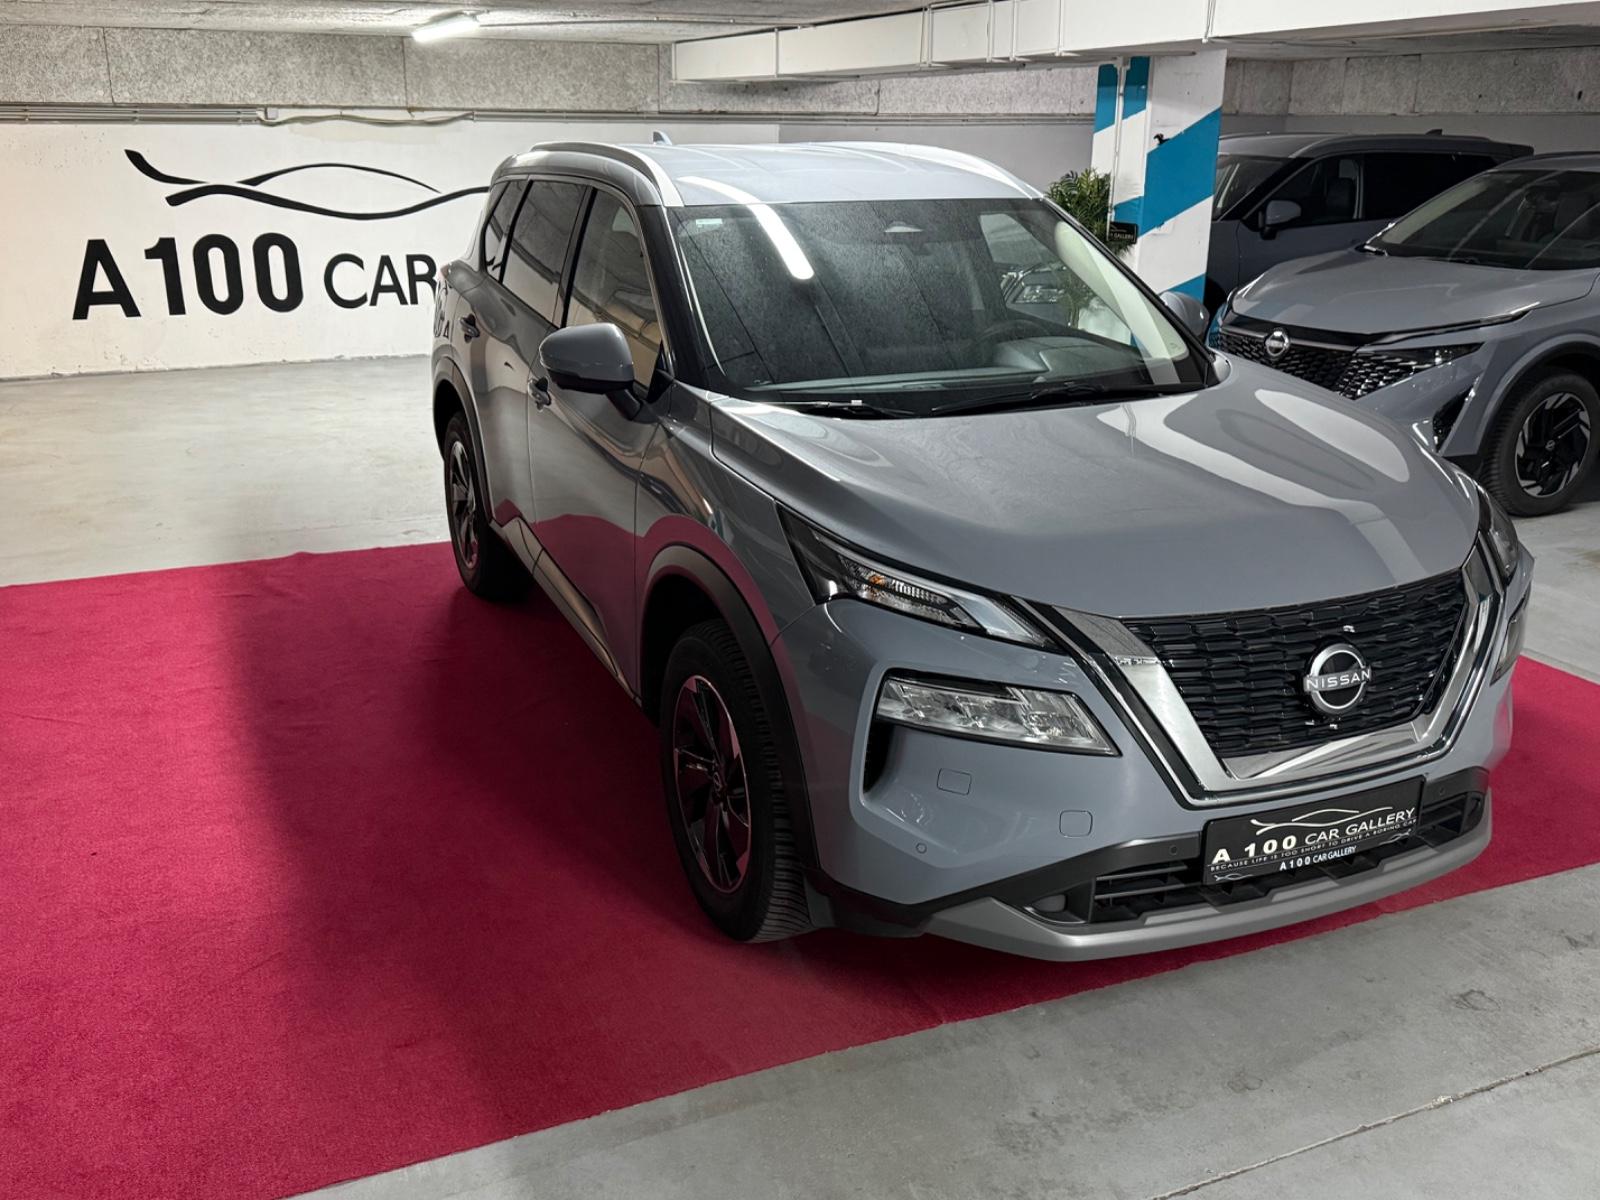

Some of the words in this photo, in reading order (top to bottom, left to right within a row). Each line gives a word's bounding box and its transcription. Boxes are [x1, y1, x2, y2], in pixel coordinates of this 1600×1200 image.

[323, 252, 438, 309] CAR
[1306, 668, 1371, 690] NISSAN
[1304, 828, 1340, 845] CAR
[1345, 807, 1415, 836] GALLERY
[1312, 853, 1327, 863] CAR
[1327, 845, 1357, 860] GALLERY
[1210, 859, 1249, 872] BECAUSE
